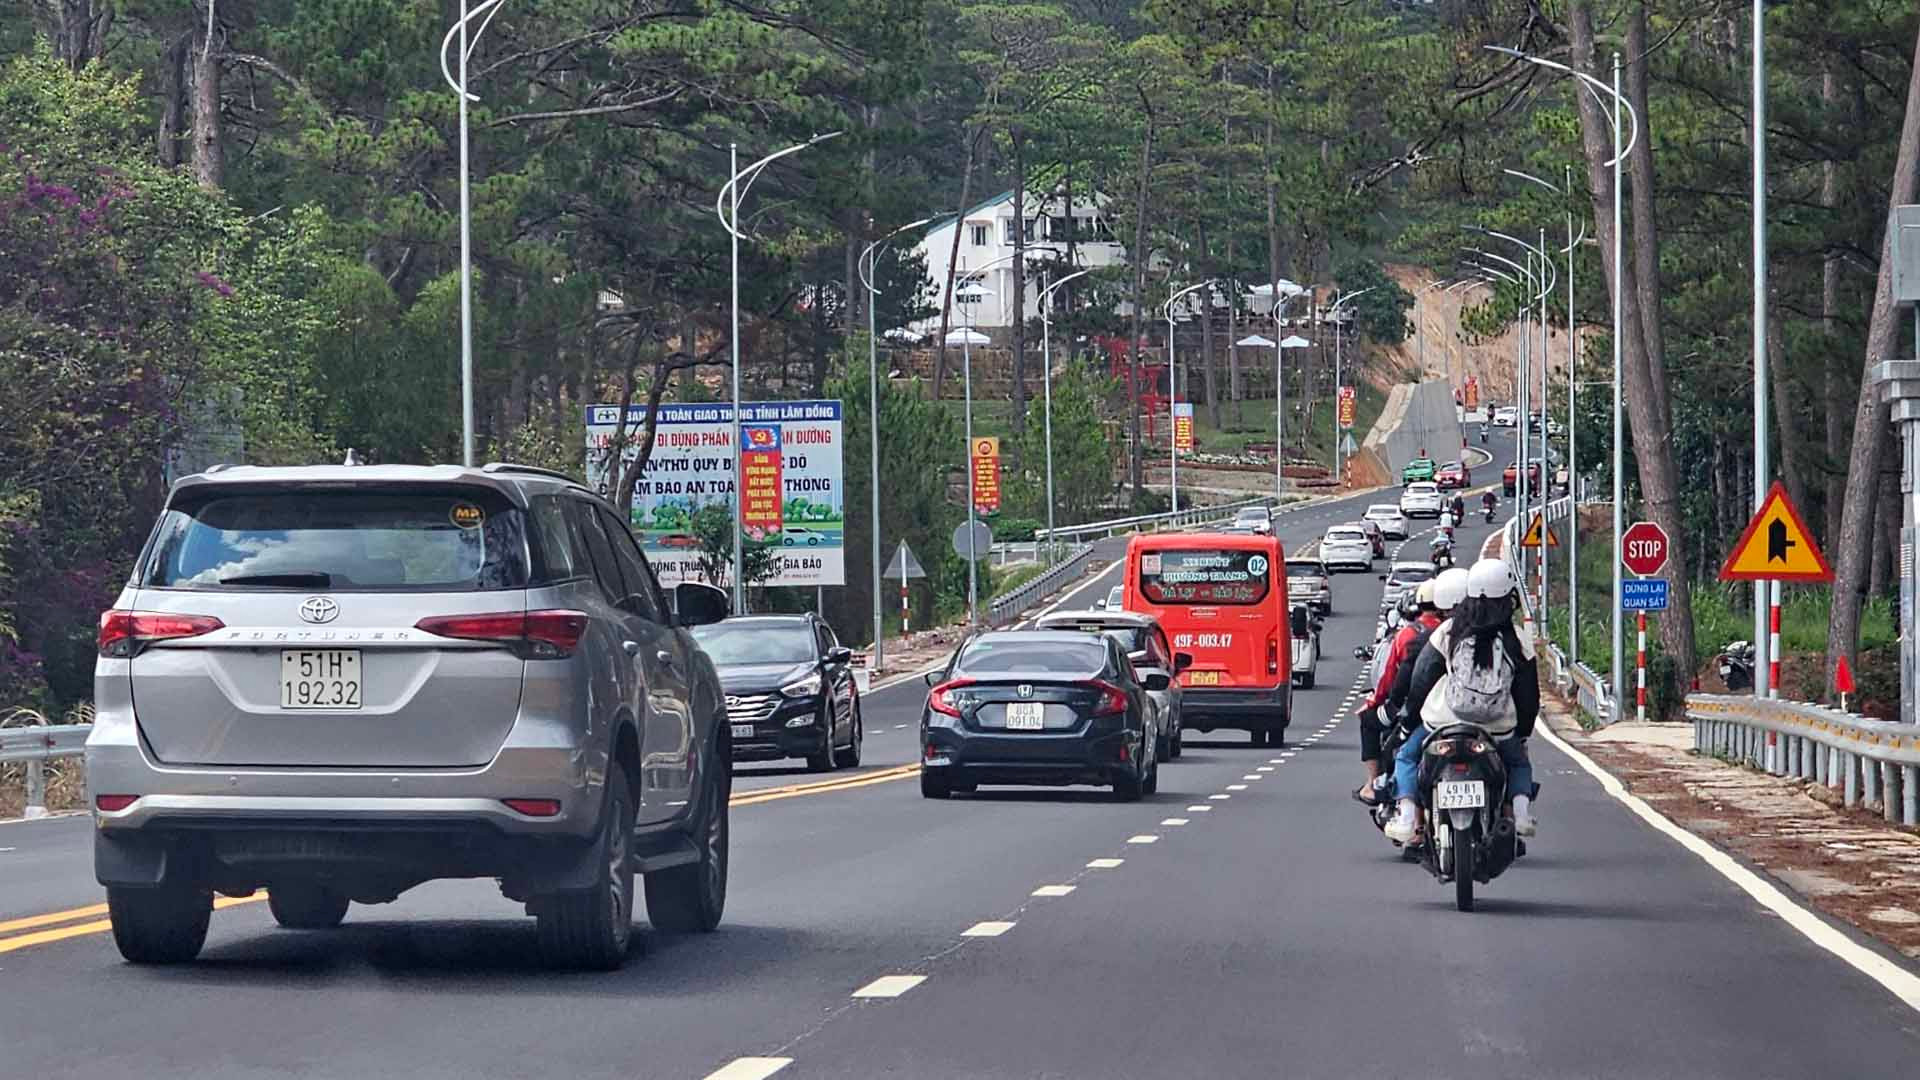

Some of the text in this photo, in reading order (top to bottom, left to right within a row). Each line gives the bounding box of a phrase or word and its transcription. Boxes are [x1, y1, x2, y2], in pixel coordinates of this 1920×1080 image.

[666, 408, 692, 421] TOÀN
[694, 409, 717, 421] GIAO
[721, 408, 753, 420] THNG
[781, 405, 803, 418] LÂM
[805, 404, 833, 418] ĐỒNG
[693, 459, 721, 473] QUY
[790, 453, 807, 472] ĐỘ
[686, 481, 705, 493] AN
[1629, 540, 1662, 558] STOP
[784, 558, 799, 569] GIA
[803, 555, 822, 569] BẢO
[1251, 559, 1265, 572] 02
[1624, 596, 1664, 607] QUAN SÁT
[1174, 633, 1233, 648] 49F-003.47
[300, 653, 342, 678] 51H
[285, 681, 358, 705] 192.32
